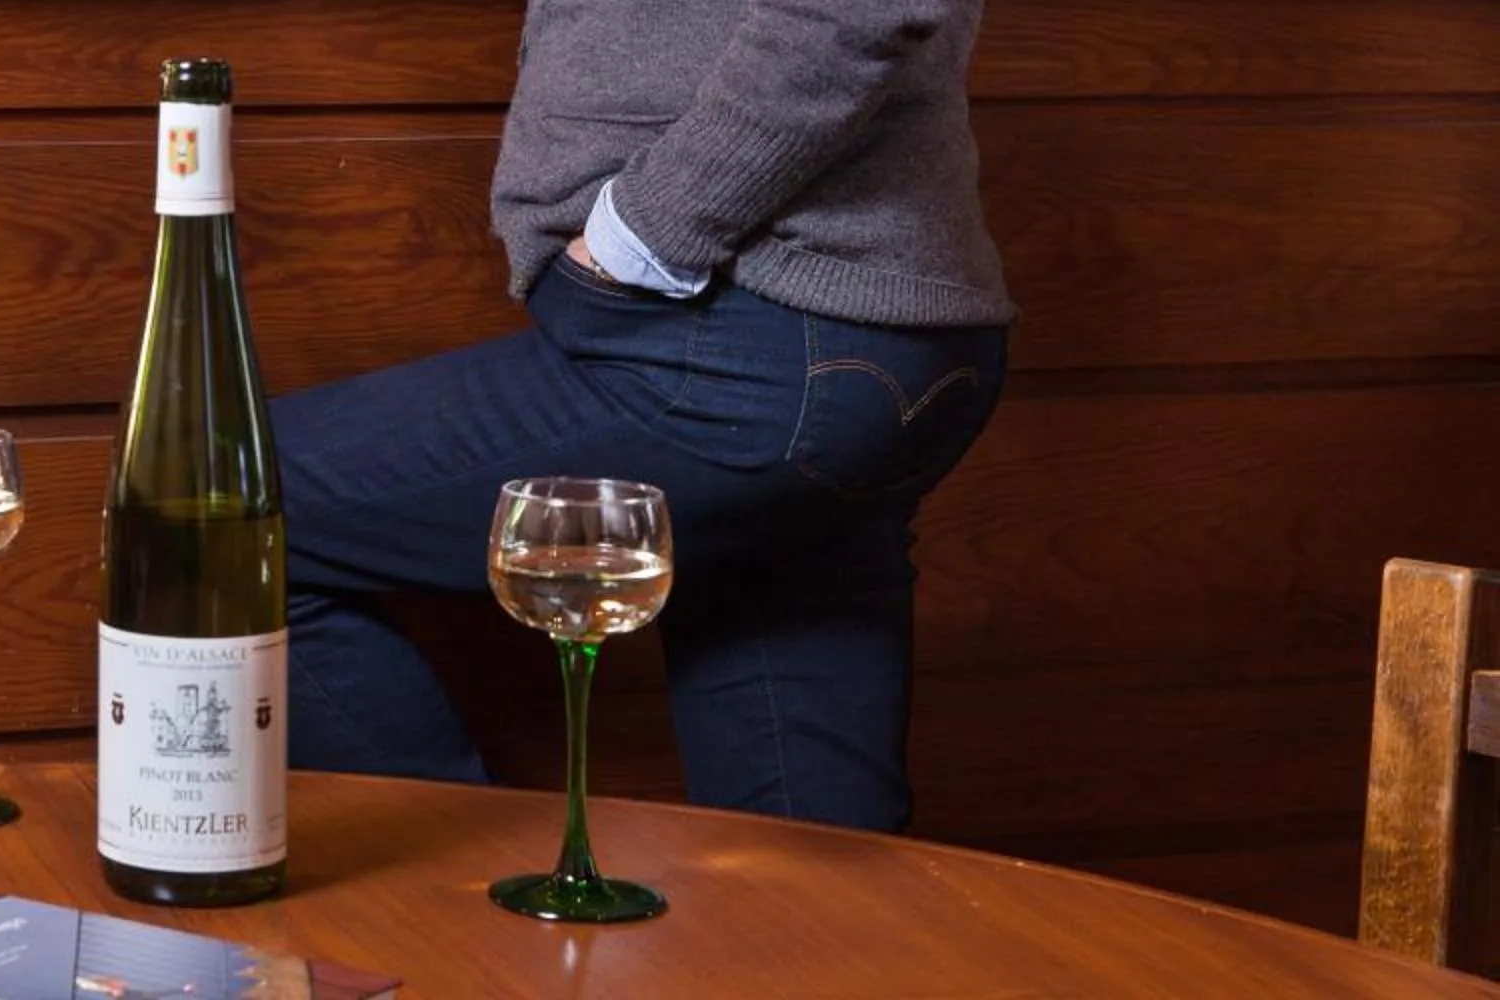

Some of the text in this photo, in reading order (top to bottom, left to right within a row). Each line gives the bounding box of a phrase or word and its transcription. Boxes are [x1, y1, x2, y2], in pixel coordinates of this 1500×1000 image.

[133, 644, 249, 662] VIN D'ALSACE
[139, 766, 239, 784] PINOT BLANC
[128, 805, 248, 835] KIENTZLER
